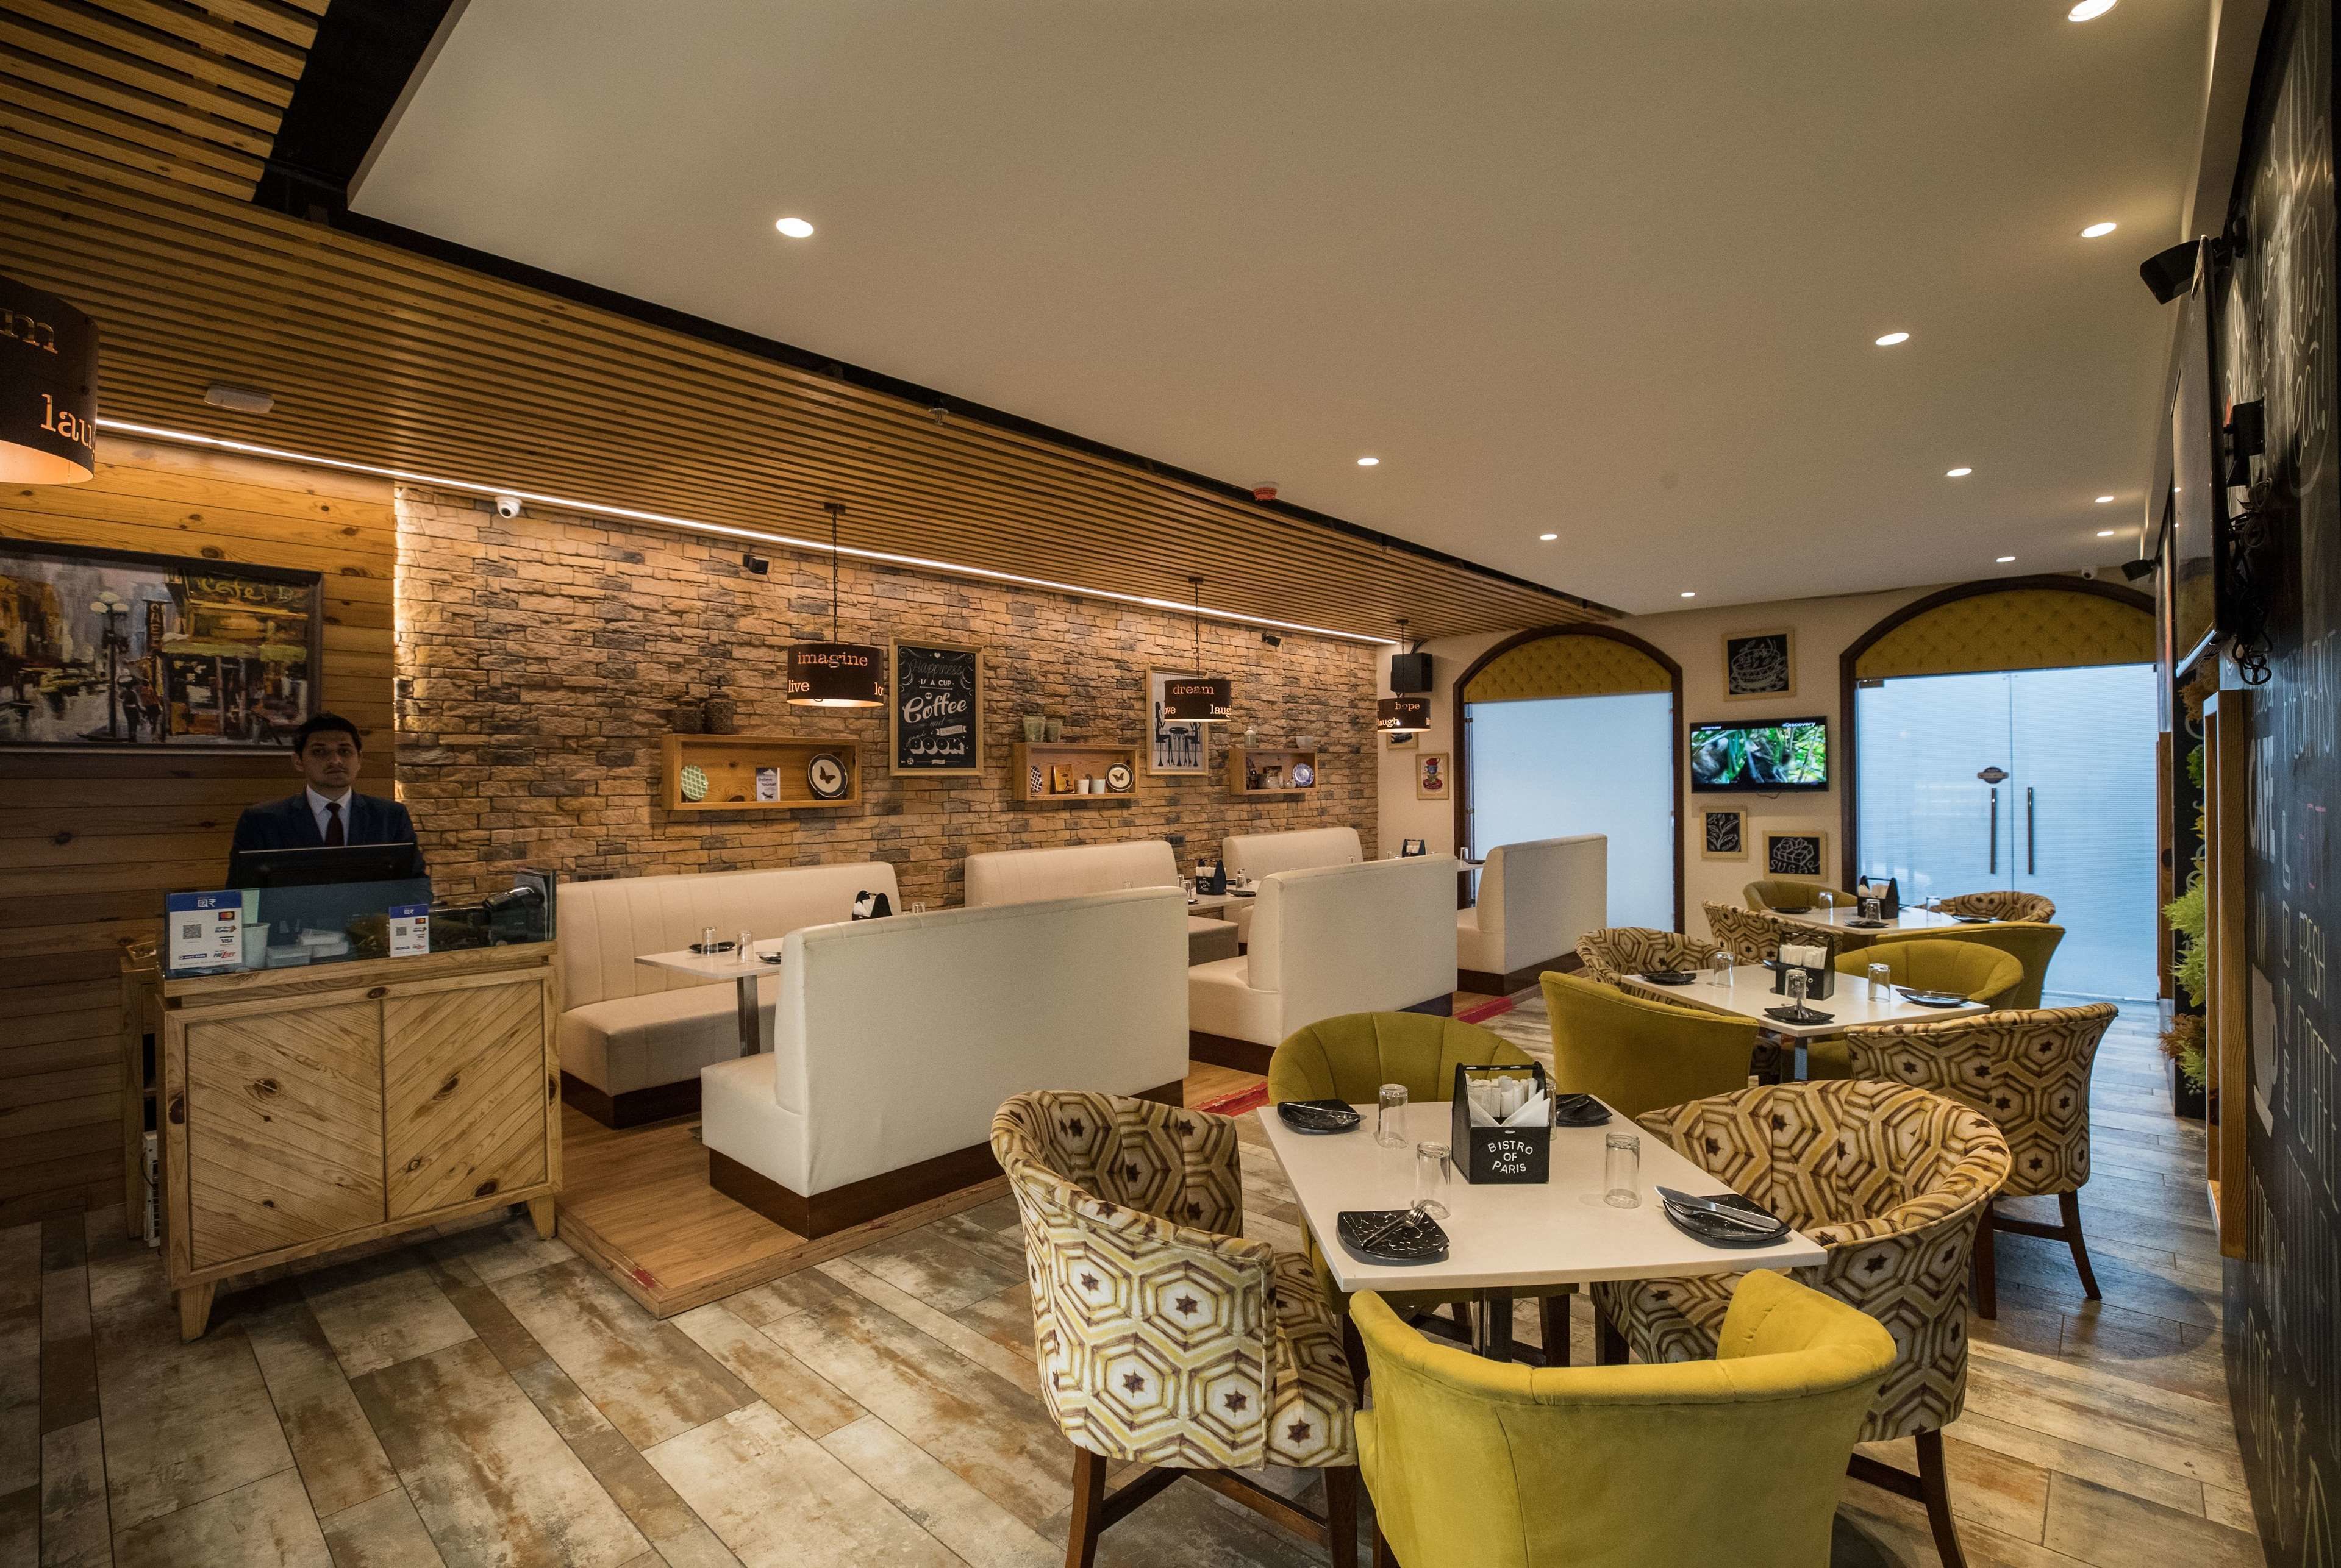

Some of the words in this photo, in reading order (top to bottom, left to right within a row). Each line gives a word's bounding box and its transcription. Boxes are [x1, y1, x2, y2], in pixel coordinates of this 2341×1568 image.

[41, 393, 95, 461] lau
[797, 652, 868, 668] imagine
[909, 659, 963, 678] Happiness
[788, 680, 810, 693] live
[1172, 684, 1215, 694] dream
[902, 693, 967, 724] Coffee
[1395, 702, 1420, 712] hope
[910, 736, 965, 755] BOOK
[2248, 735, 2275, 863] CAFE
[1770, 859, 1820, 874] SUGAR
[2299, 910, 2326, 1010] FRESH
[2298, 1005, 2339, 1214] COFFEE
[1487, 1140, 1534, 1156] BISTRO
[1503, 1152, 1518, 1161] OF
[1492, 1160, 1527, 1174] PARIS
